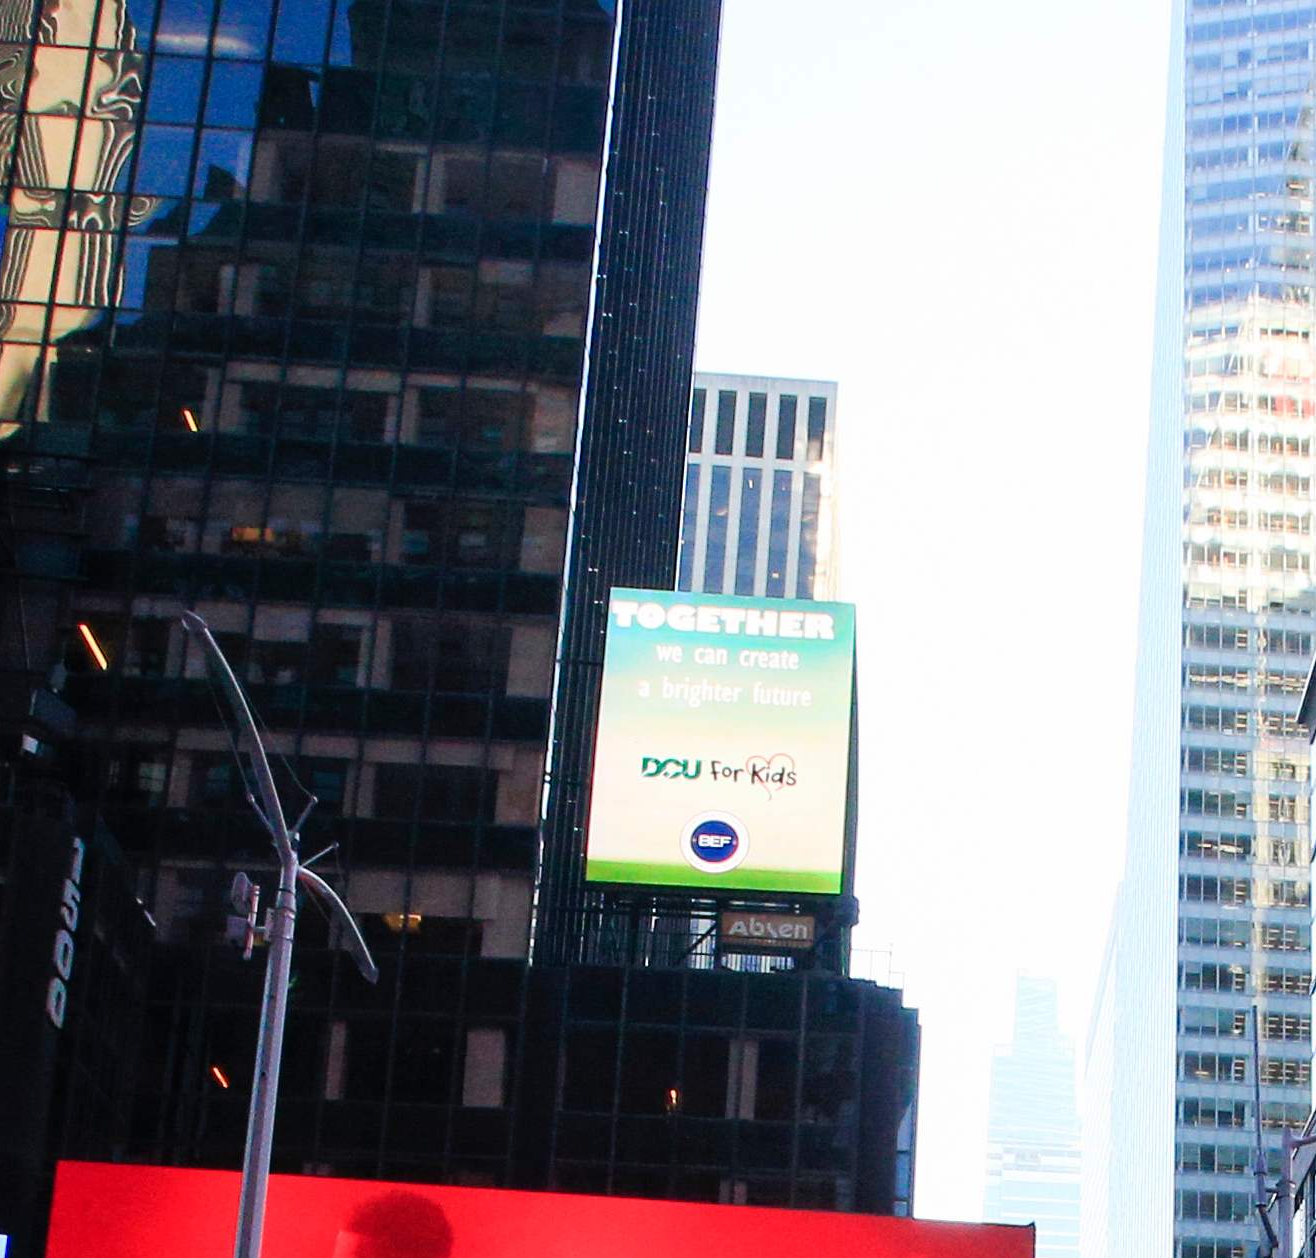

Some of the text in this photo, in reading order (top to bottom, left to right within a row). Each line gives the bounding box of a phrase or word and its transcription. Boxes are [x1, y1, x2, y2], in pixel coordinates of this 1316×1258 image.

[612, 601, 834, 640] TOGETHER
[656, 644, 800, 671] we can create
[638, 677, 812, 709] a brighter future
[641, 757, 797, 786] DCU for Kids
